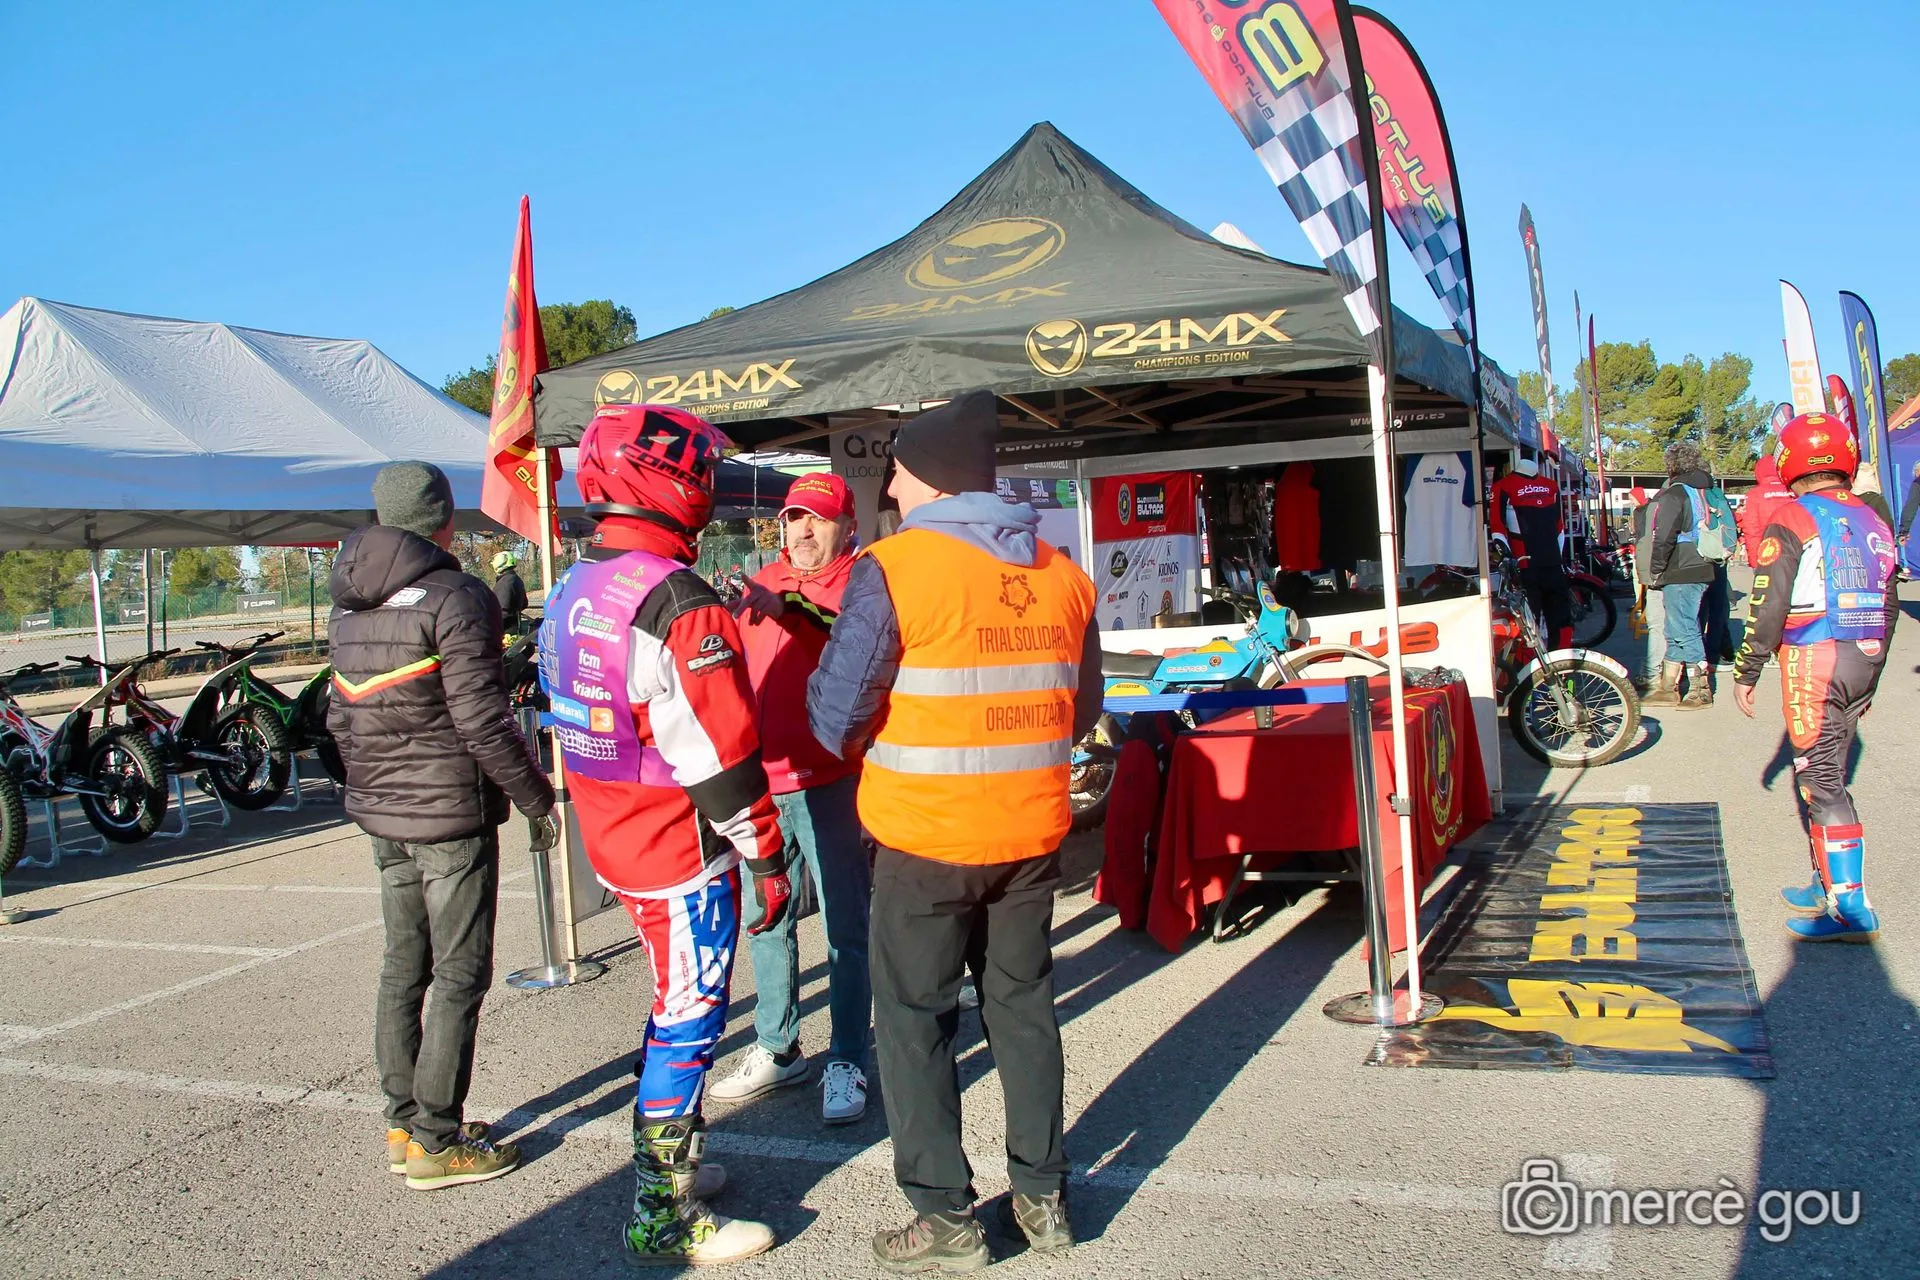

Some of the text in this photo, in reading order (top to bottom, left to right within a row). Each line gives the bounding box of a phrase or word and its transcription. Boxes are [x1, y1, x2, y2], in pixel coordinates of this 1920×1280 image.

[1092, 308, 1293, 358] 24MX
[1133, 350, 1251, 370] CHAMPIONS EDITION
[646, 358, 803, 405] 24MX
[732, 397, 769, 411] EDITION
[578, 616, 614, 632] CIRCUIT
[578, 648, 601, 670] fcm
[687, 649, 734, 671] Beta
[572, 680, 613, 702] TrialGo
[1527, 807, 1645, 963] BULTACO
